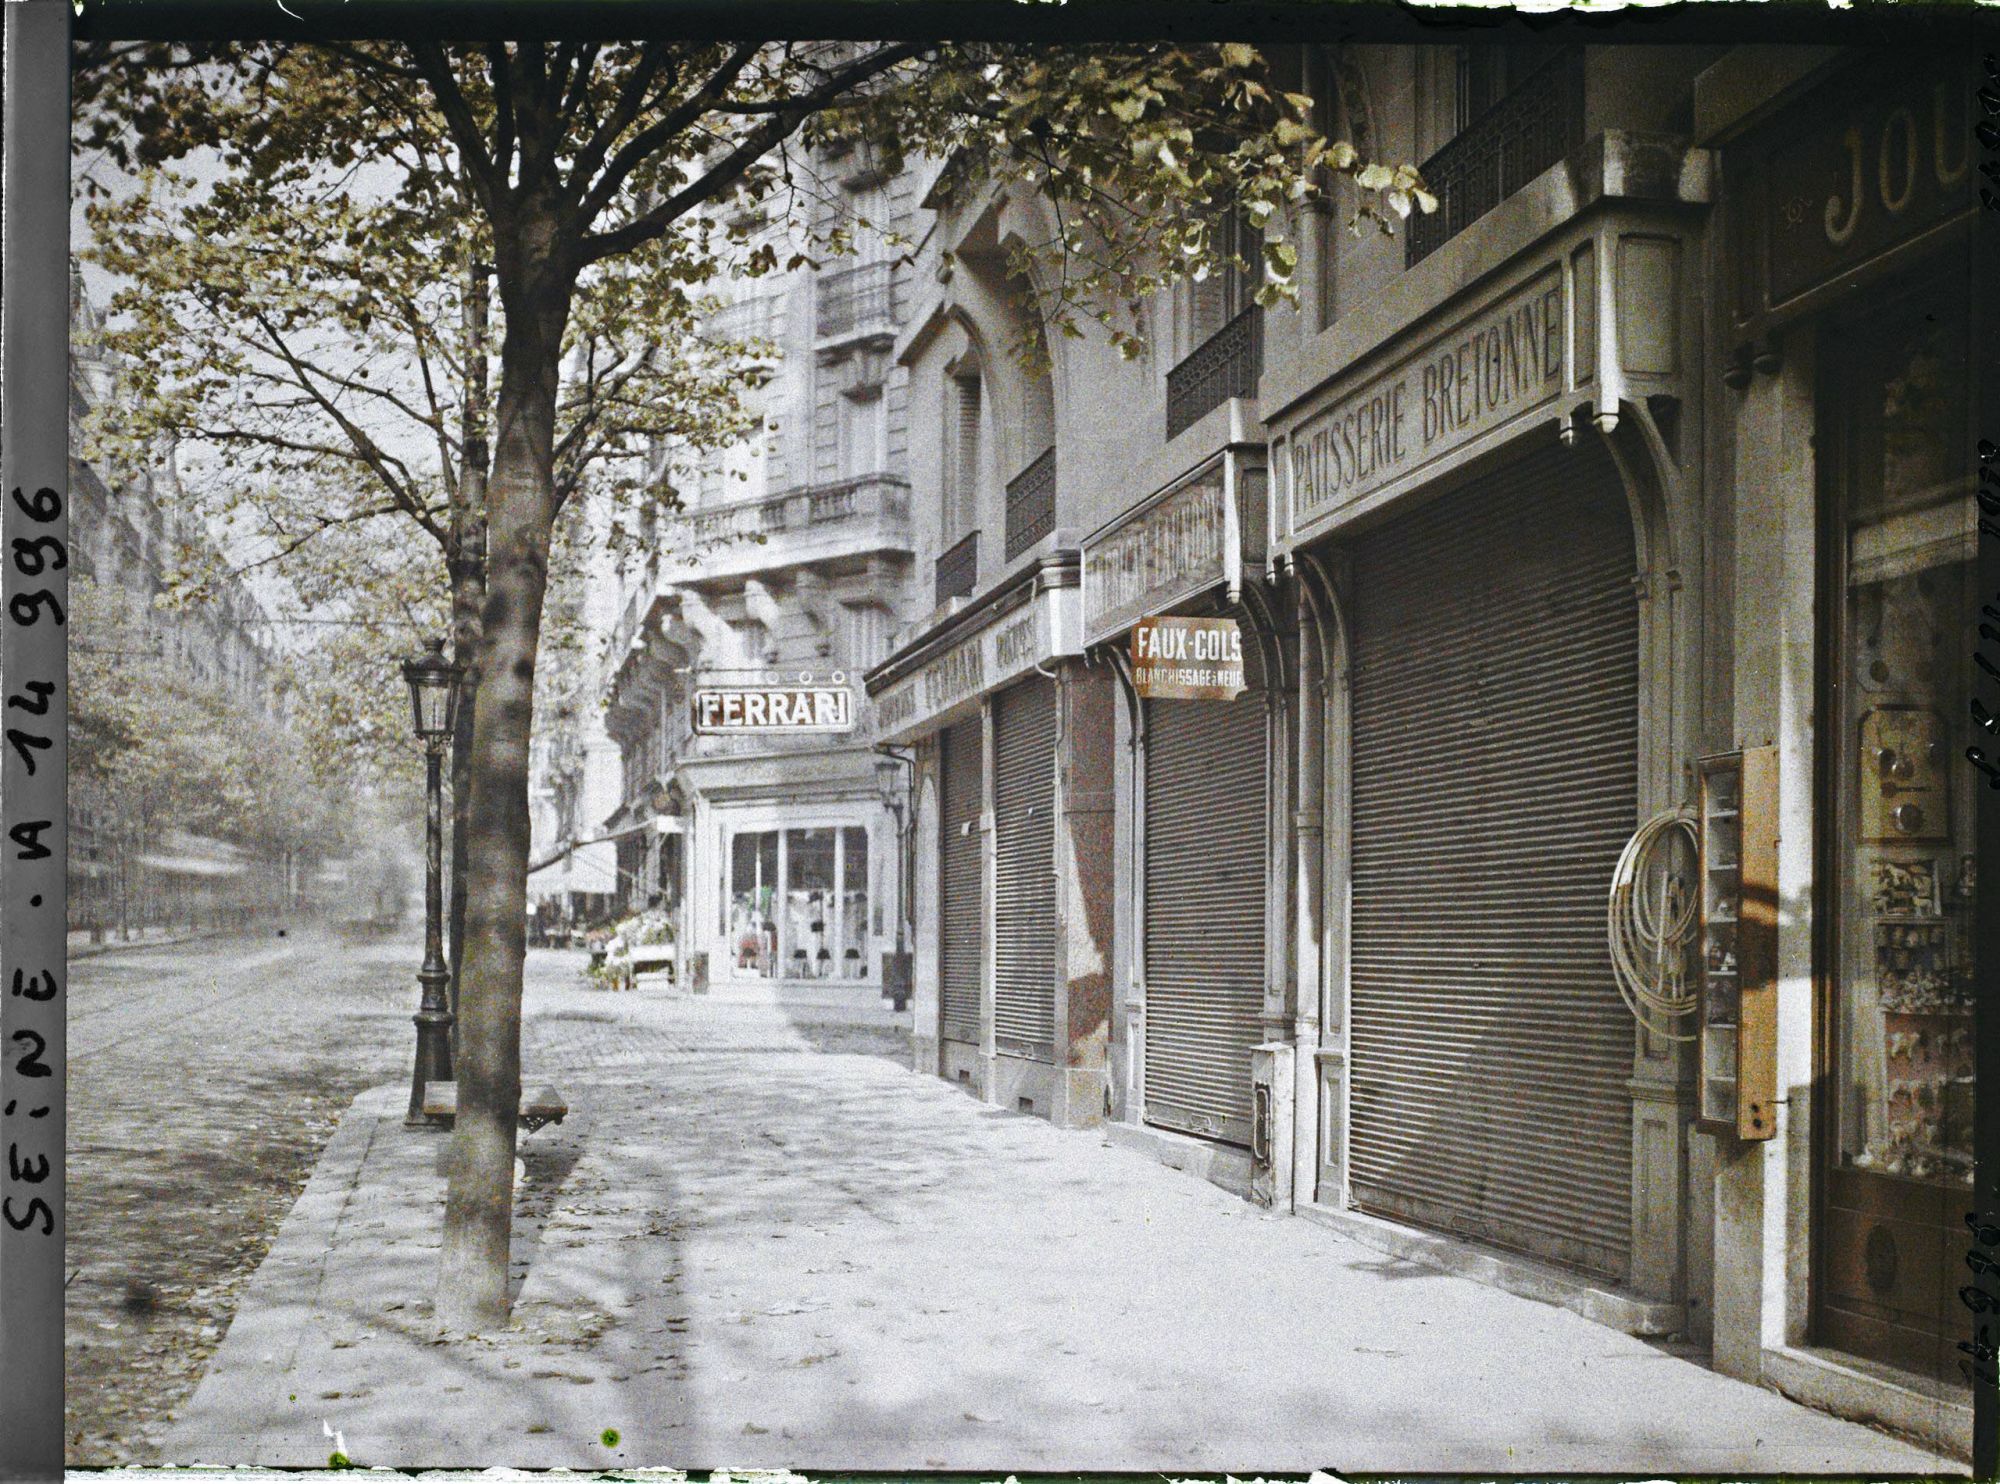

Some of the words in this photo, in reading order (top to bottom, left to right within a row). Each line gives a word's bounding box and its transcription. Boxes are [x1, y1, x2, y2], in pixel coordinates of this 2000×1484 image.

[1294, 381, 1405, 512] PATISSERIE
[1423, 287, 1560, 447] BRETONNE
[1138, 627, 1242, 661] FAUX-COLS
[1136, 667, 1211, 687] BLANCHISSAGE
[701, 693, 847, 726] FERRARI
